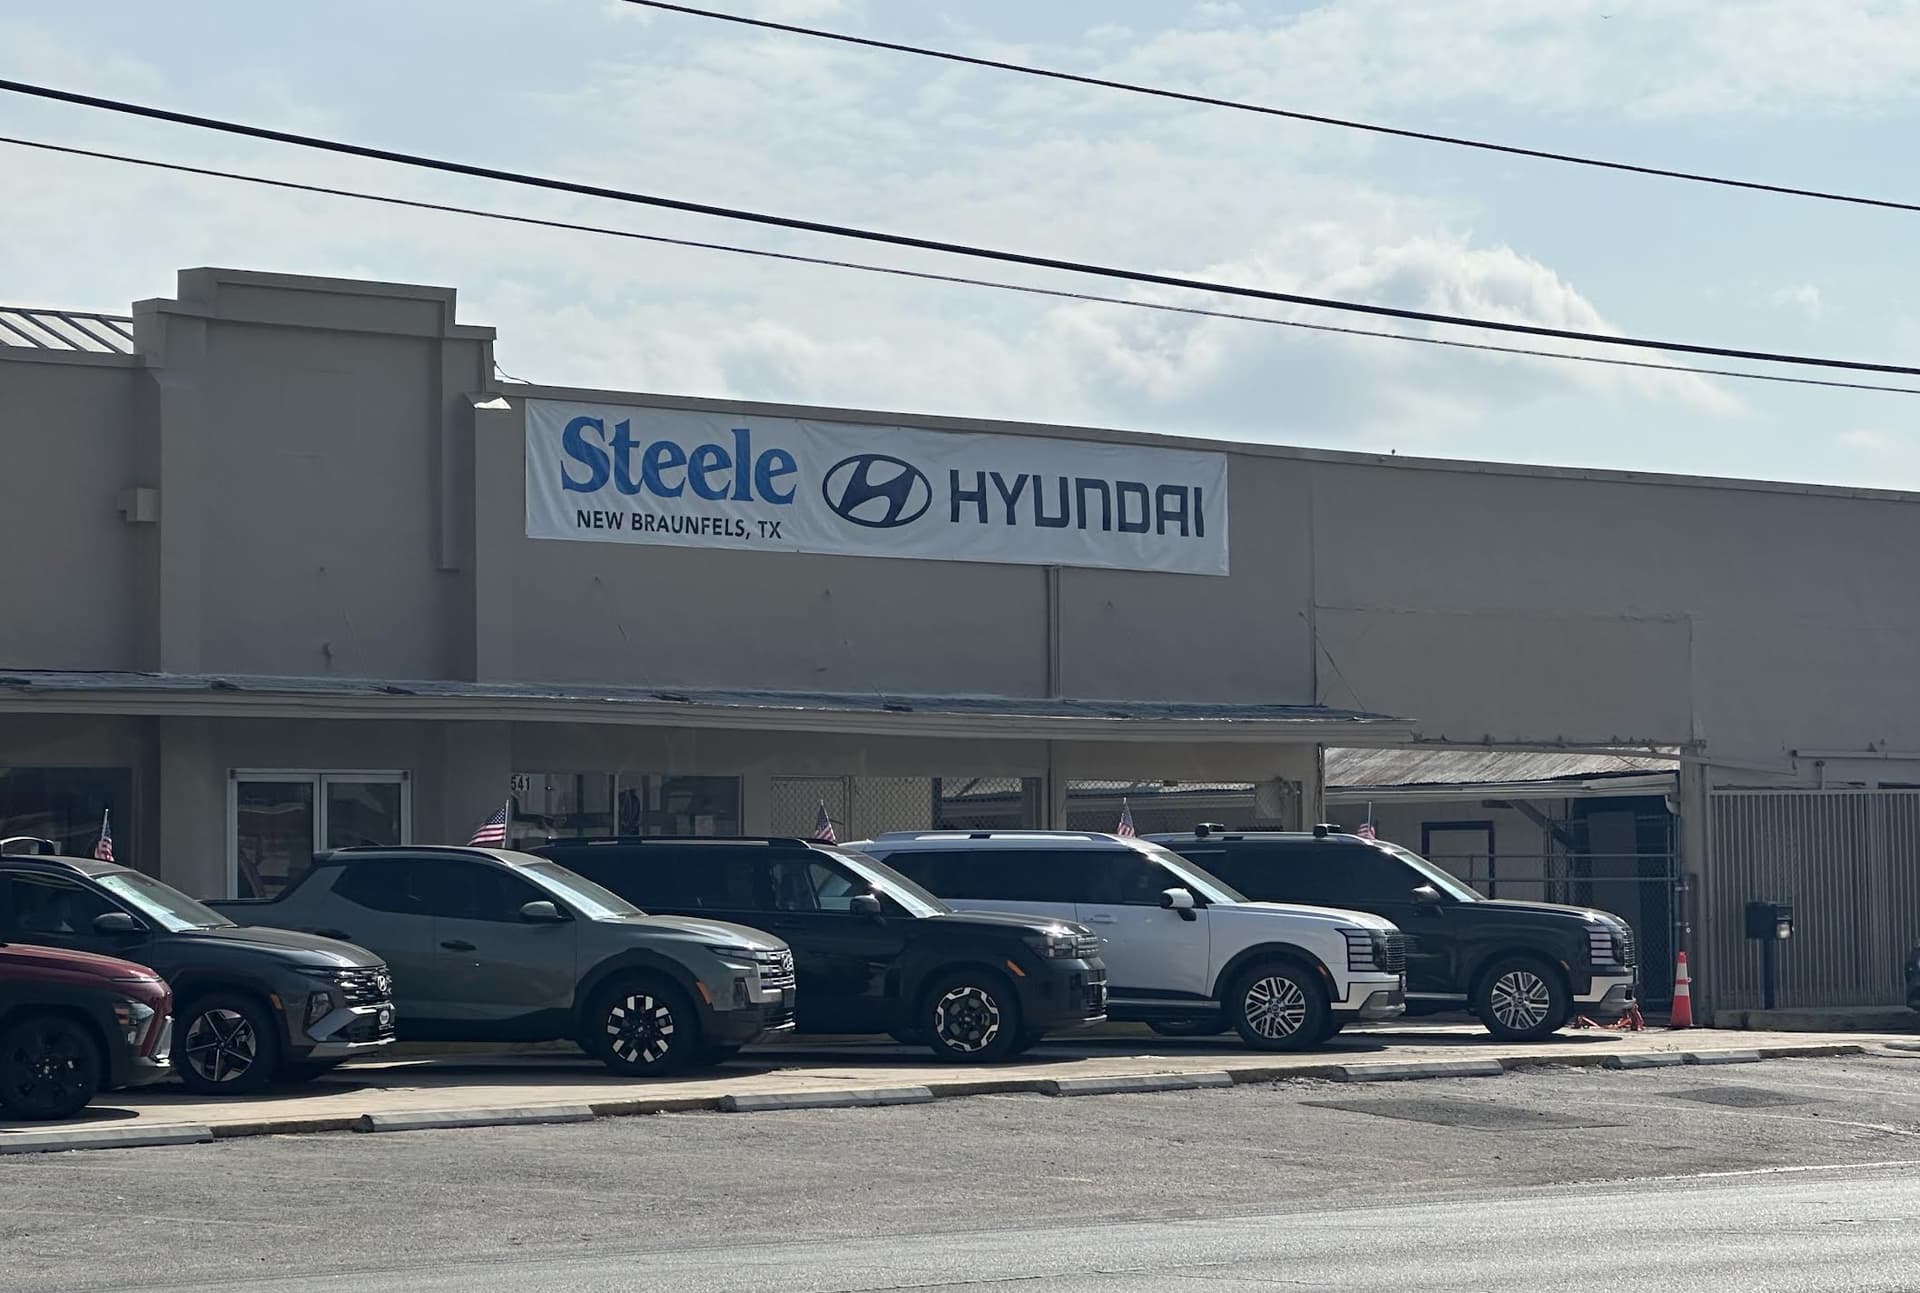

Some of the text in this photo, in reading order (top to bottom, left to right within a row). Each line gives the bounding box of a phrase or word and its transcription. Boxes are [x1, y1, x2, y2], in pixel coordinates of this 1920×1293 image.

[560, 416, 798, 505] Steele
[576, 509, 783, 541] NEW BRAUNFELS, TX
[949, 469, 1205, 538] HYUNDAI
[511, 774, 530, 791] 541
